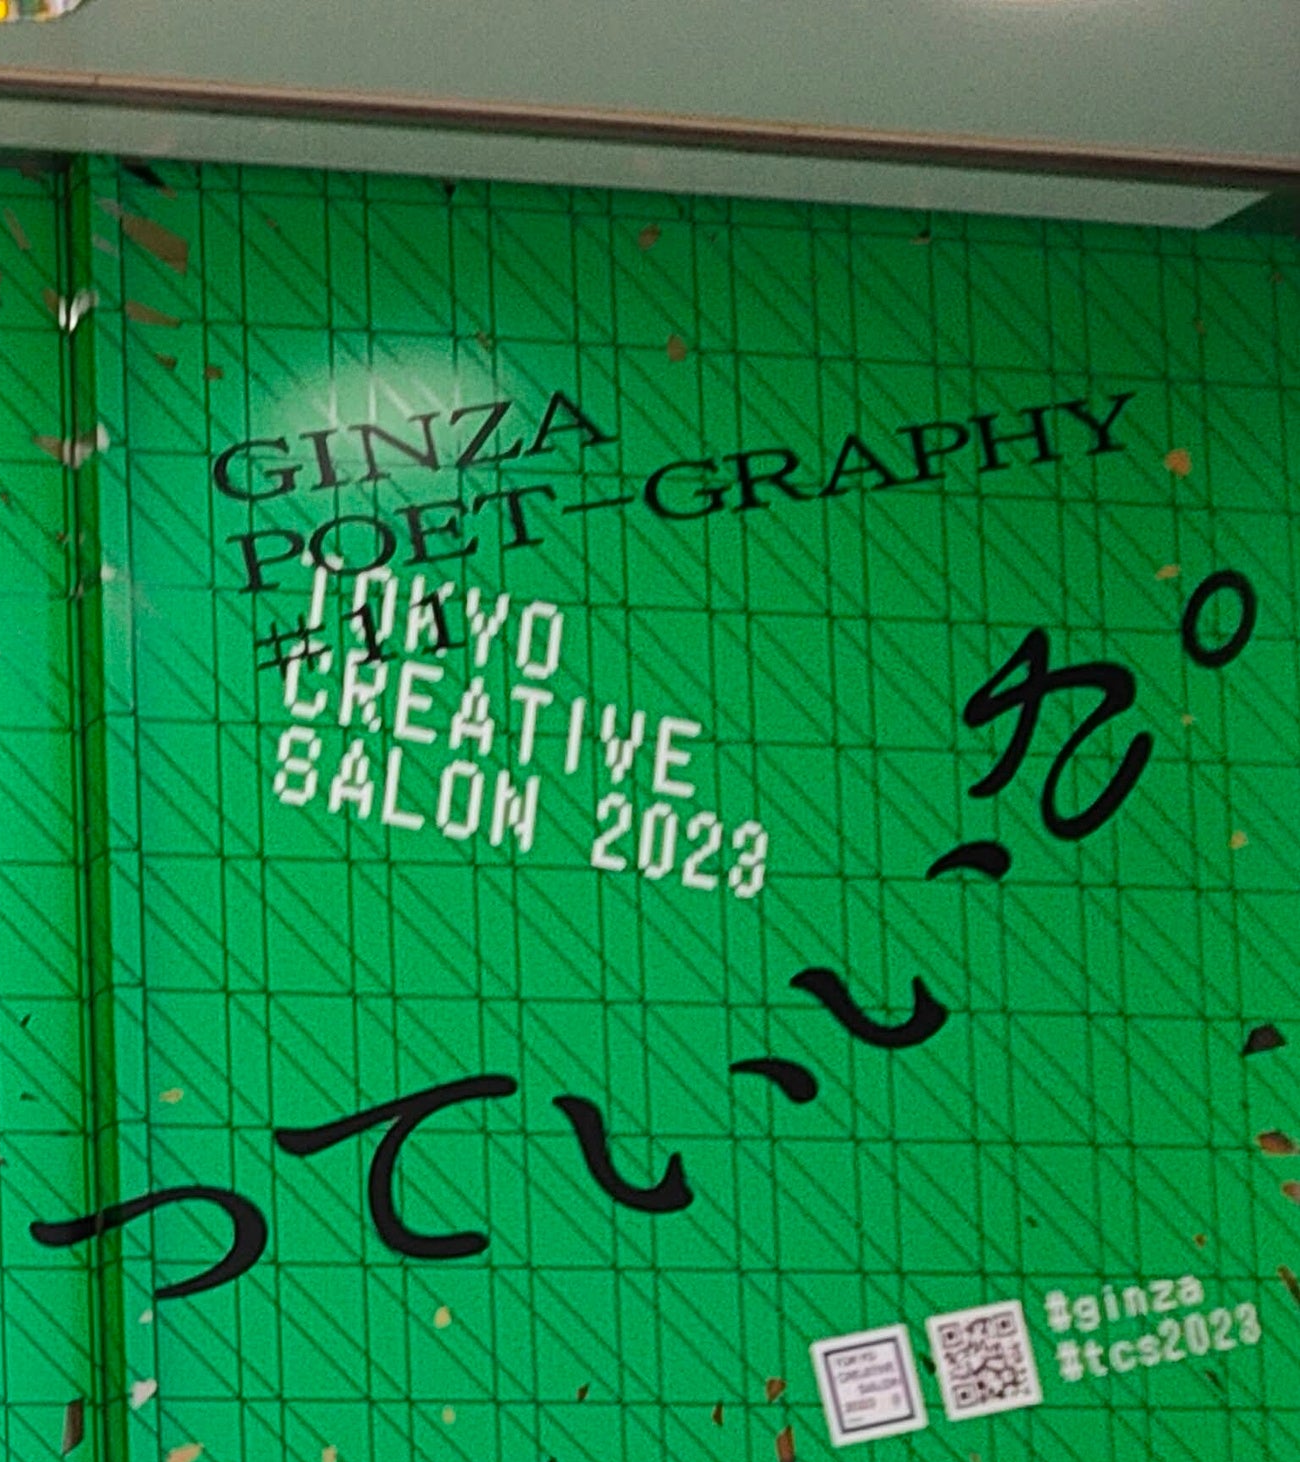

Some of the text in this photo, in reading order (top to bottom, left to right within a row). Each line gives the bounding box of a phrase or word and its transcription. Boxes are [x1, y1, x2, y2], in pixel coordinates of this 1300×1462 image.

[212, 390, 621, 503] GINZA
[284, 637, 701, 800] CREATIVE
[273, 725, 768, 899] SALON 2023
[1043, 1275, 1205, 1332] #ginza
[1054, 1302, 1262, 1383] #tcs2023
